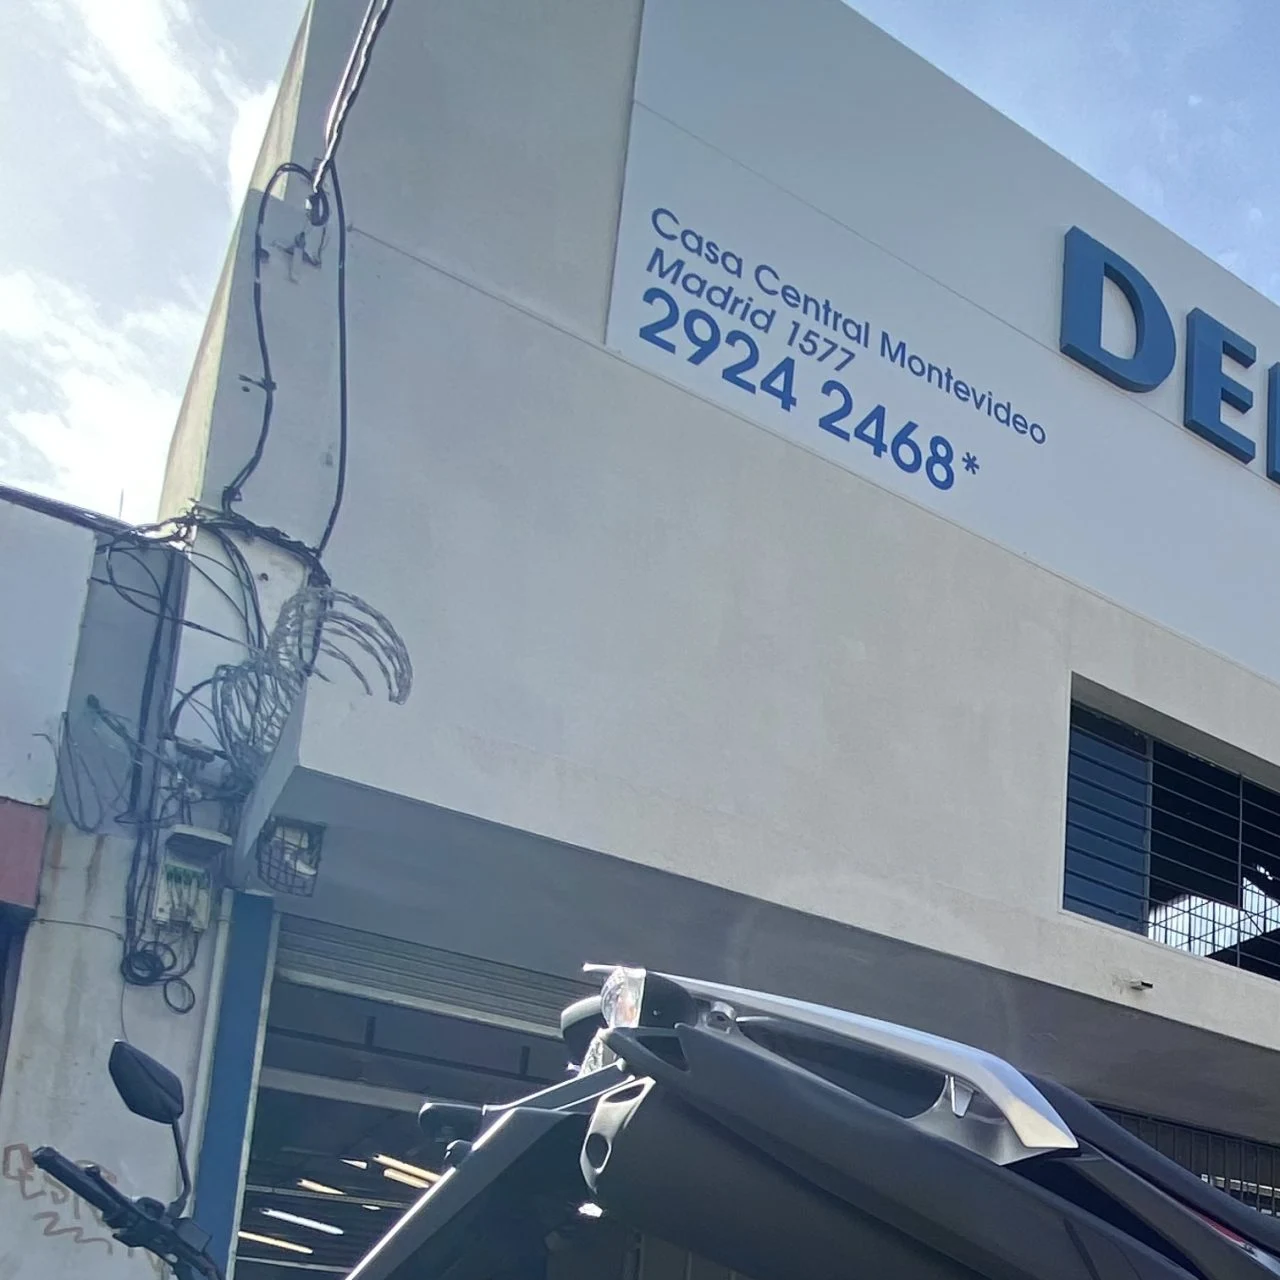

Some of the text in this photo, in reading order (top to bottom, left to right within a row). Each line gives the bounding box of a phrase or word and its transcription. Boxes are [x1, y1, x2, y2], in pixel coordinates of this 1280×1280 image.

[639, 287, 797, 412] 2924
[646, 247, 856, 372] Madrid 1577
[651, 208, 1046, 445] Casa Central Montevideo
